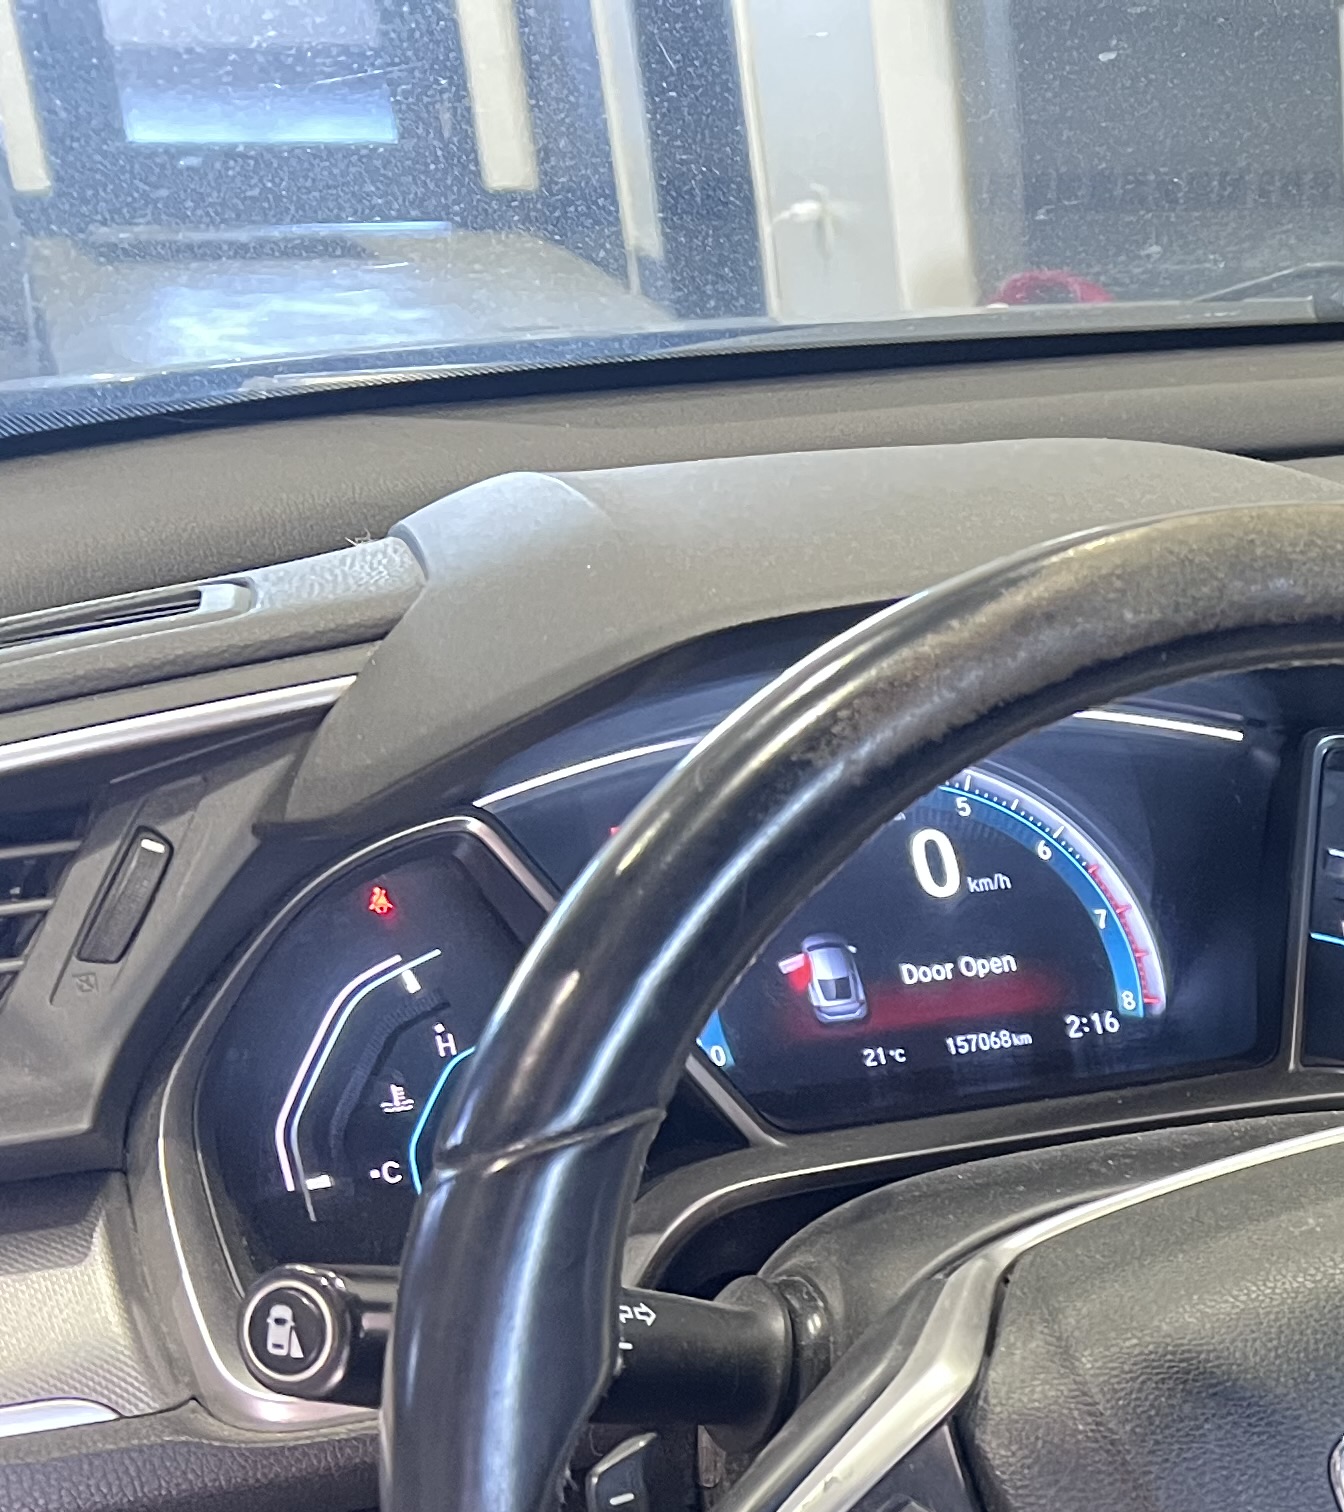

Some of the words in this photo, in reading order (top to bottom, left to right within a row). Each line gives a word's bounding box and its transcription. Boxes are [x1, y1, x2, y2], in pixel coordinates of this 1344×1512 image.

[956, 796, 972, 817] 5
[1037, 839, 1053, 860] 6
[911, 827, 961, 899] 0
[966, 873, 1013, 893] km/h
[1094, 908, 1107, 930] 7
[901, 962, 954, 986] Door
[958, 953, 1018, 979] Open
[1121, 990, 1137, 1011] 8
[1064, 1010, 1121, 1039] 2:16
[434, 1032, 458, 1058] H
[710, 1045, 727, 1067] 0
[380, 1160, 403, 1184] C
